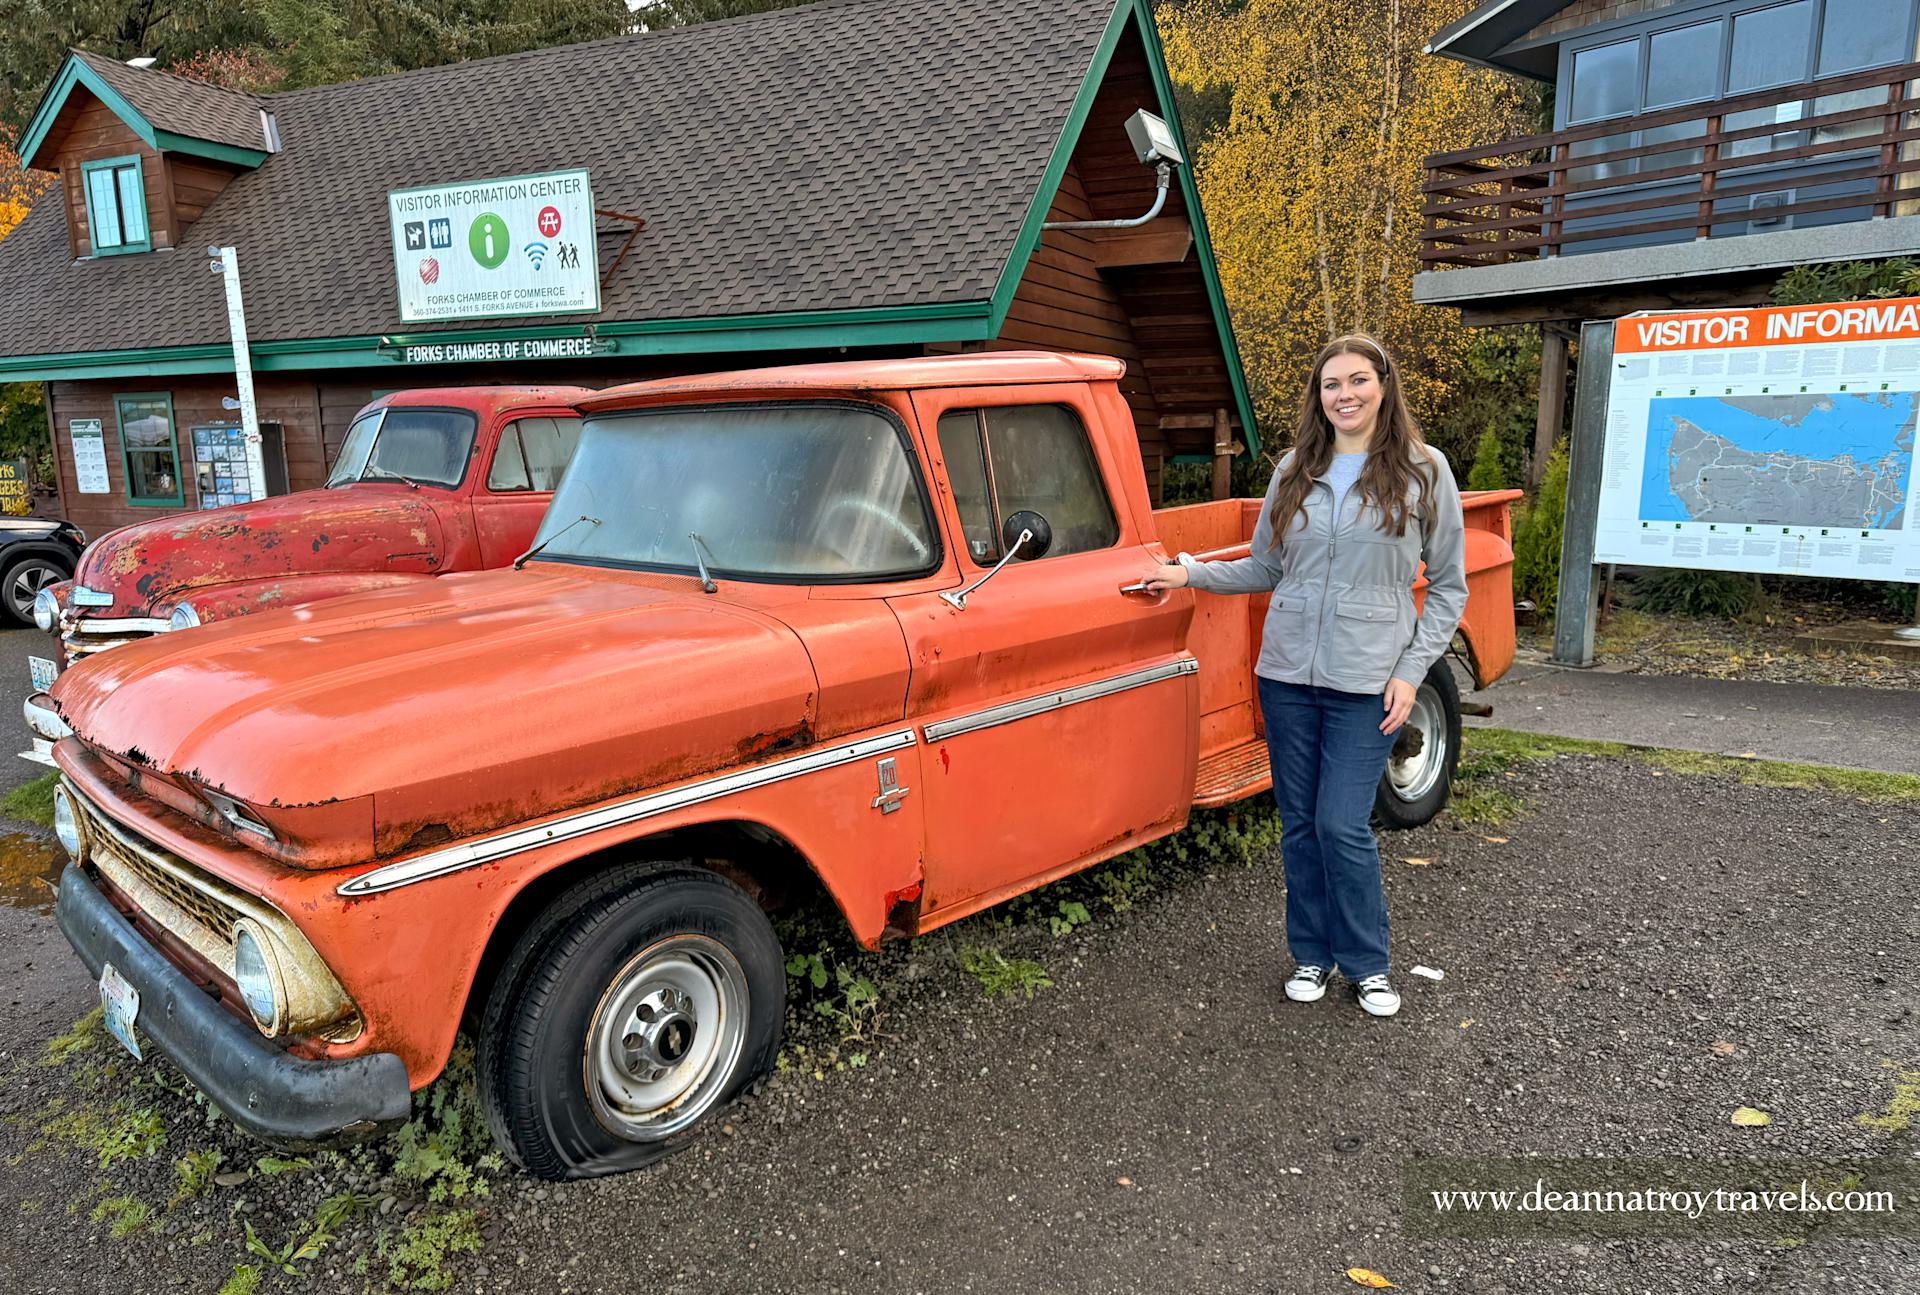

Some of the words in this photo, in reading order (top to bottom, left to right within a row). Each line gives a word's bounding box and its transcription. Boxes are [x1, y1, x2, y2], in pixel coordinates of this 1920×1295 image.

[396, 194, 441, 212] VISITOR
[444, 184, 527, 207] INFORMATION
[530, 178, 581, 198] CENTER
[427, 294, 455, 305] FORKS
[456, 291, 499, 303] CHAMBER
[500, 289, 512, 300] OF
[514, 286, 565, 299] COMMERCE
[458, 305, 473, 313] 1411
[482, 302, 505, 311] FORKS
[506, 301, 534, 310] AVENUE
[541, 299, 584, 308] forkswa.com
[1637, 316, 1750, 347] VISITOR
[1765, 304, 1920, 339] INFORMA
[406, 345, 443, 362] FORKS
[446, 342, 502, 360] CHAMBER
[504, 341, 520, 358] OF
[524, 337, 592, 357] COMMERCE
